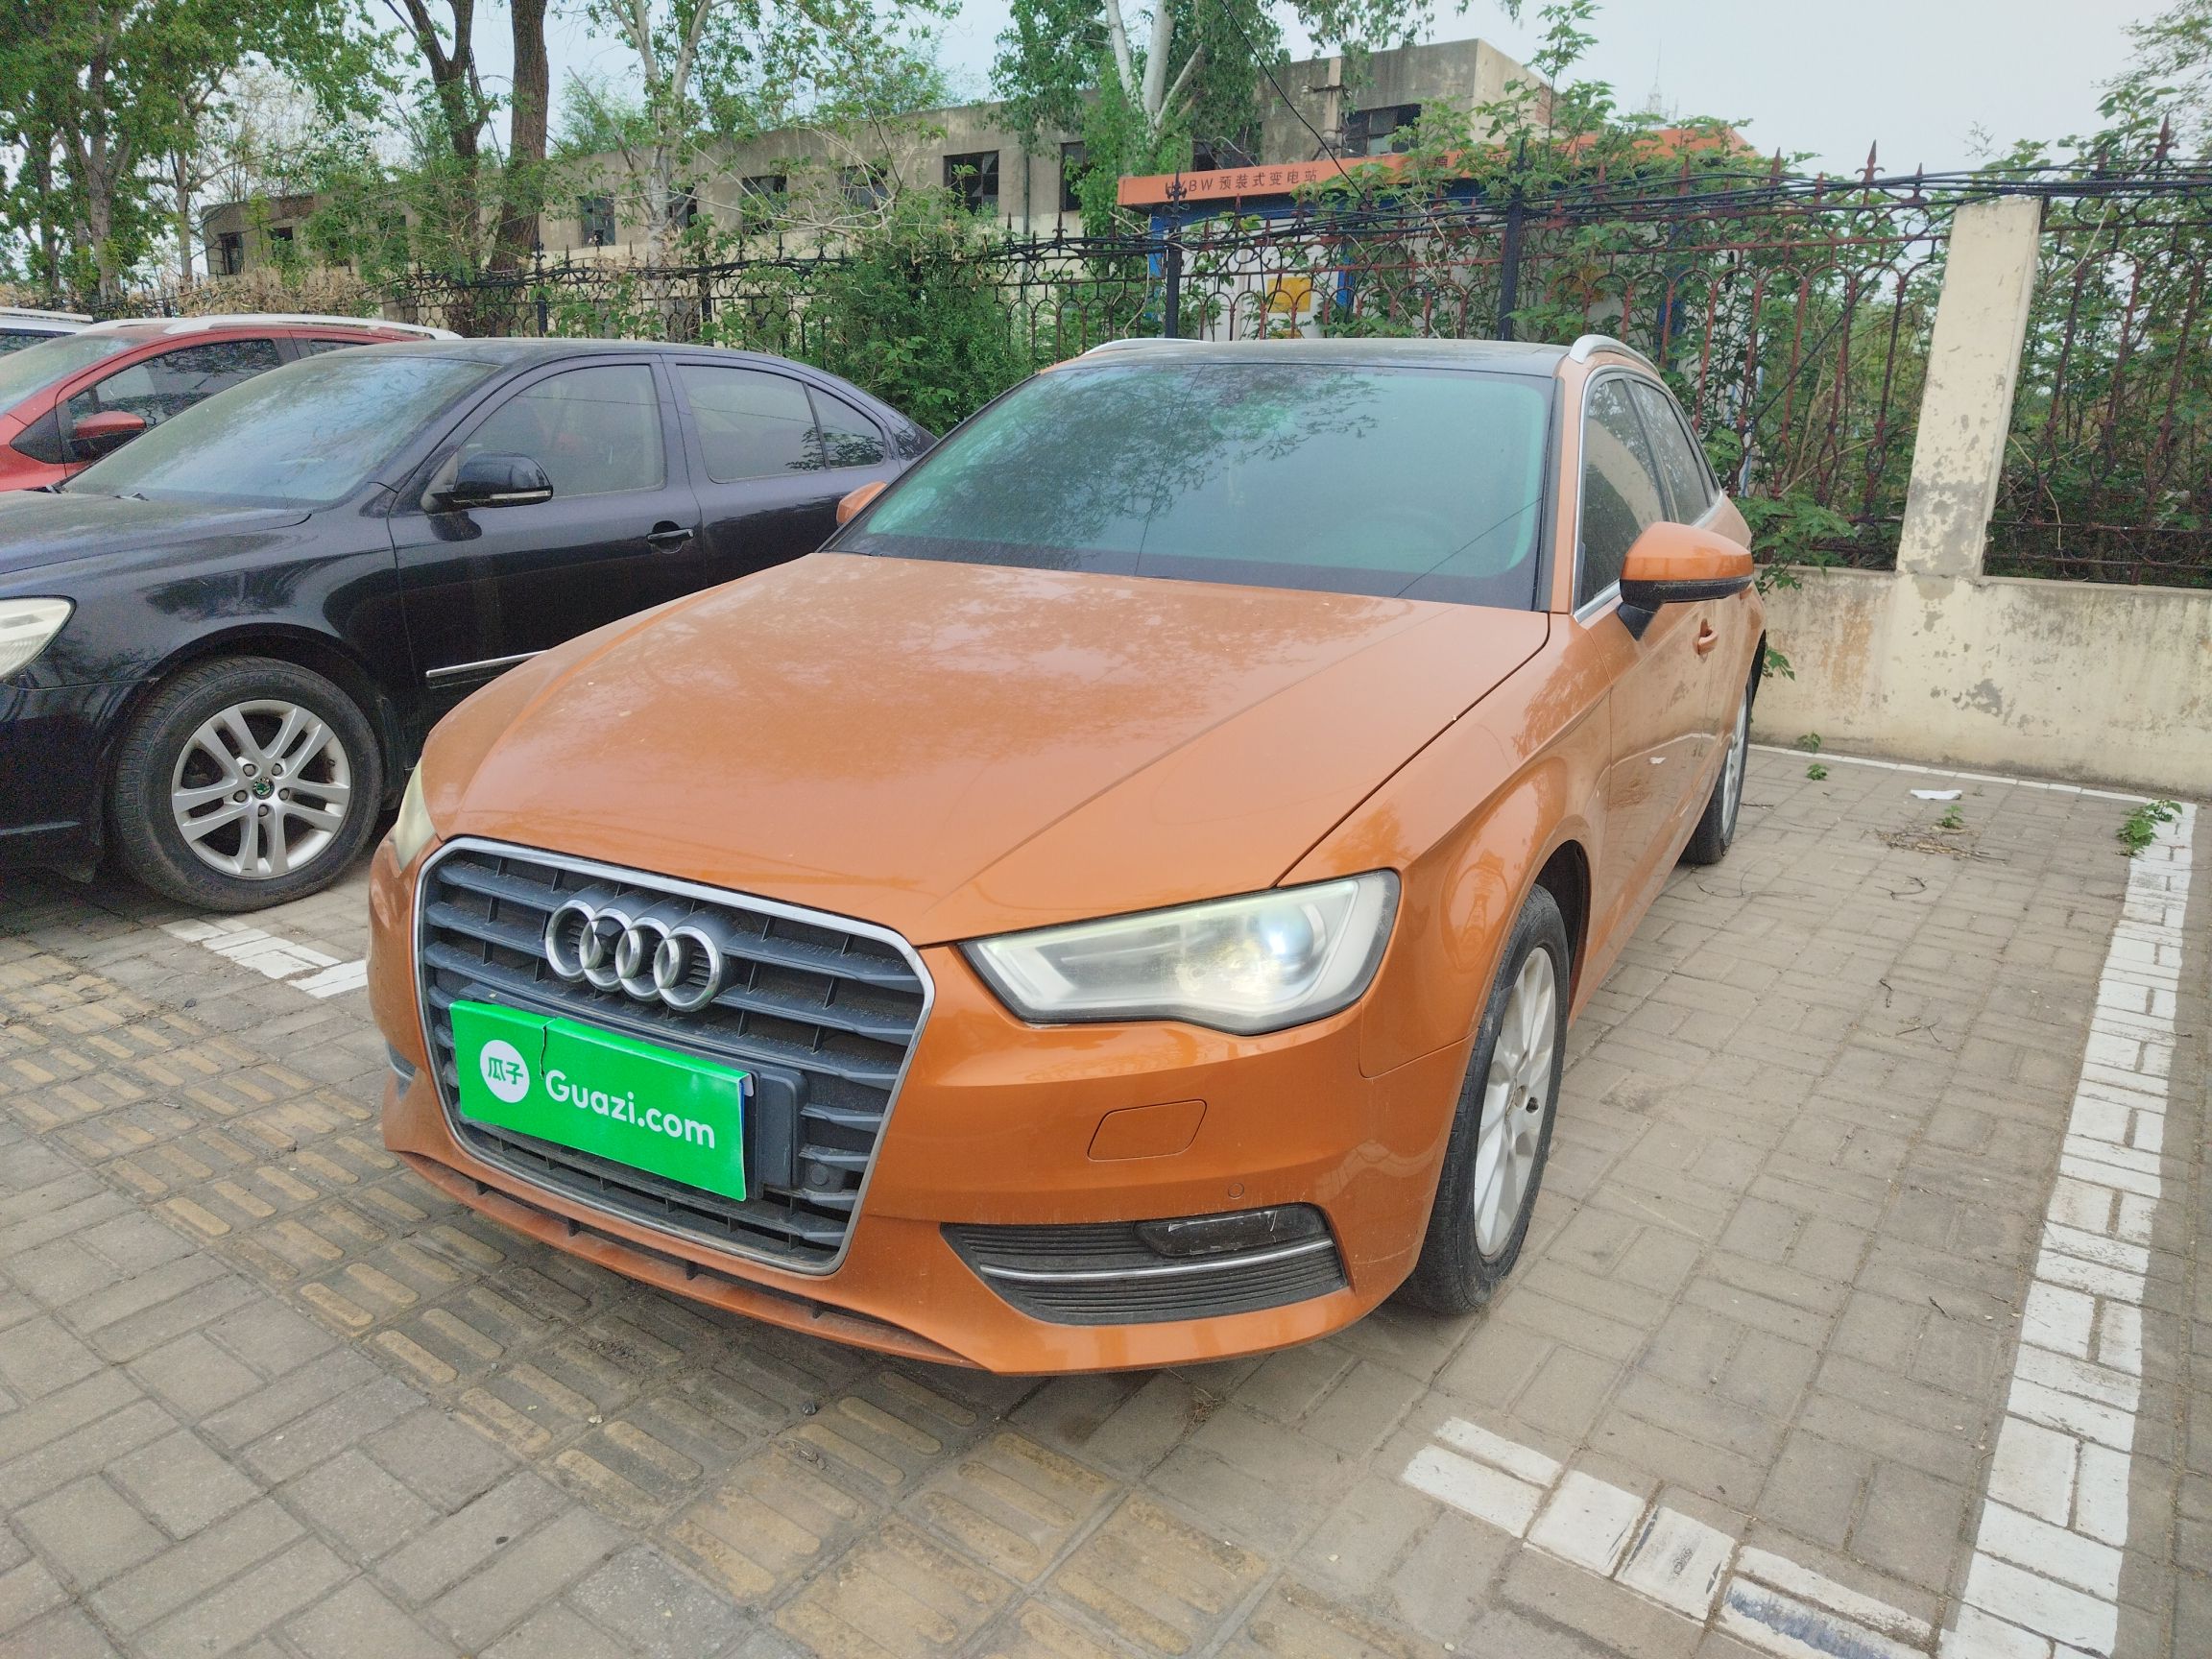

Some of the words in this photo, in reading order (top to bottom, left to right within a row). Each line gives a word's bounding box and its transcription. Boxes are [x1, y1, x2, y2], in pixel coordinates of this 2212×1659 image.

[1219, 168, 1317, 190] 预装式变电站
[488, 1057, 524, 1085] 瓜子
[545, 1070, 715, 1149] Guazi.com
